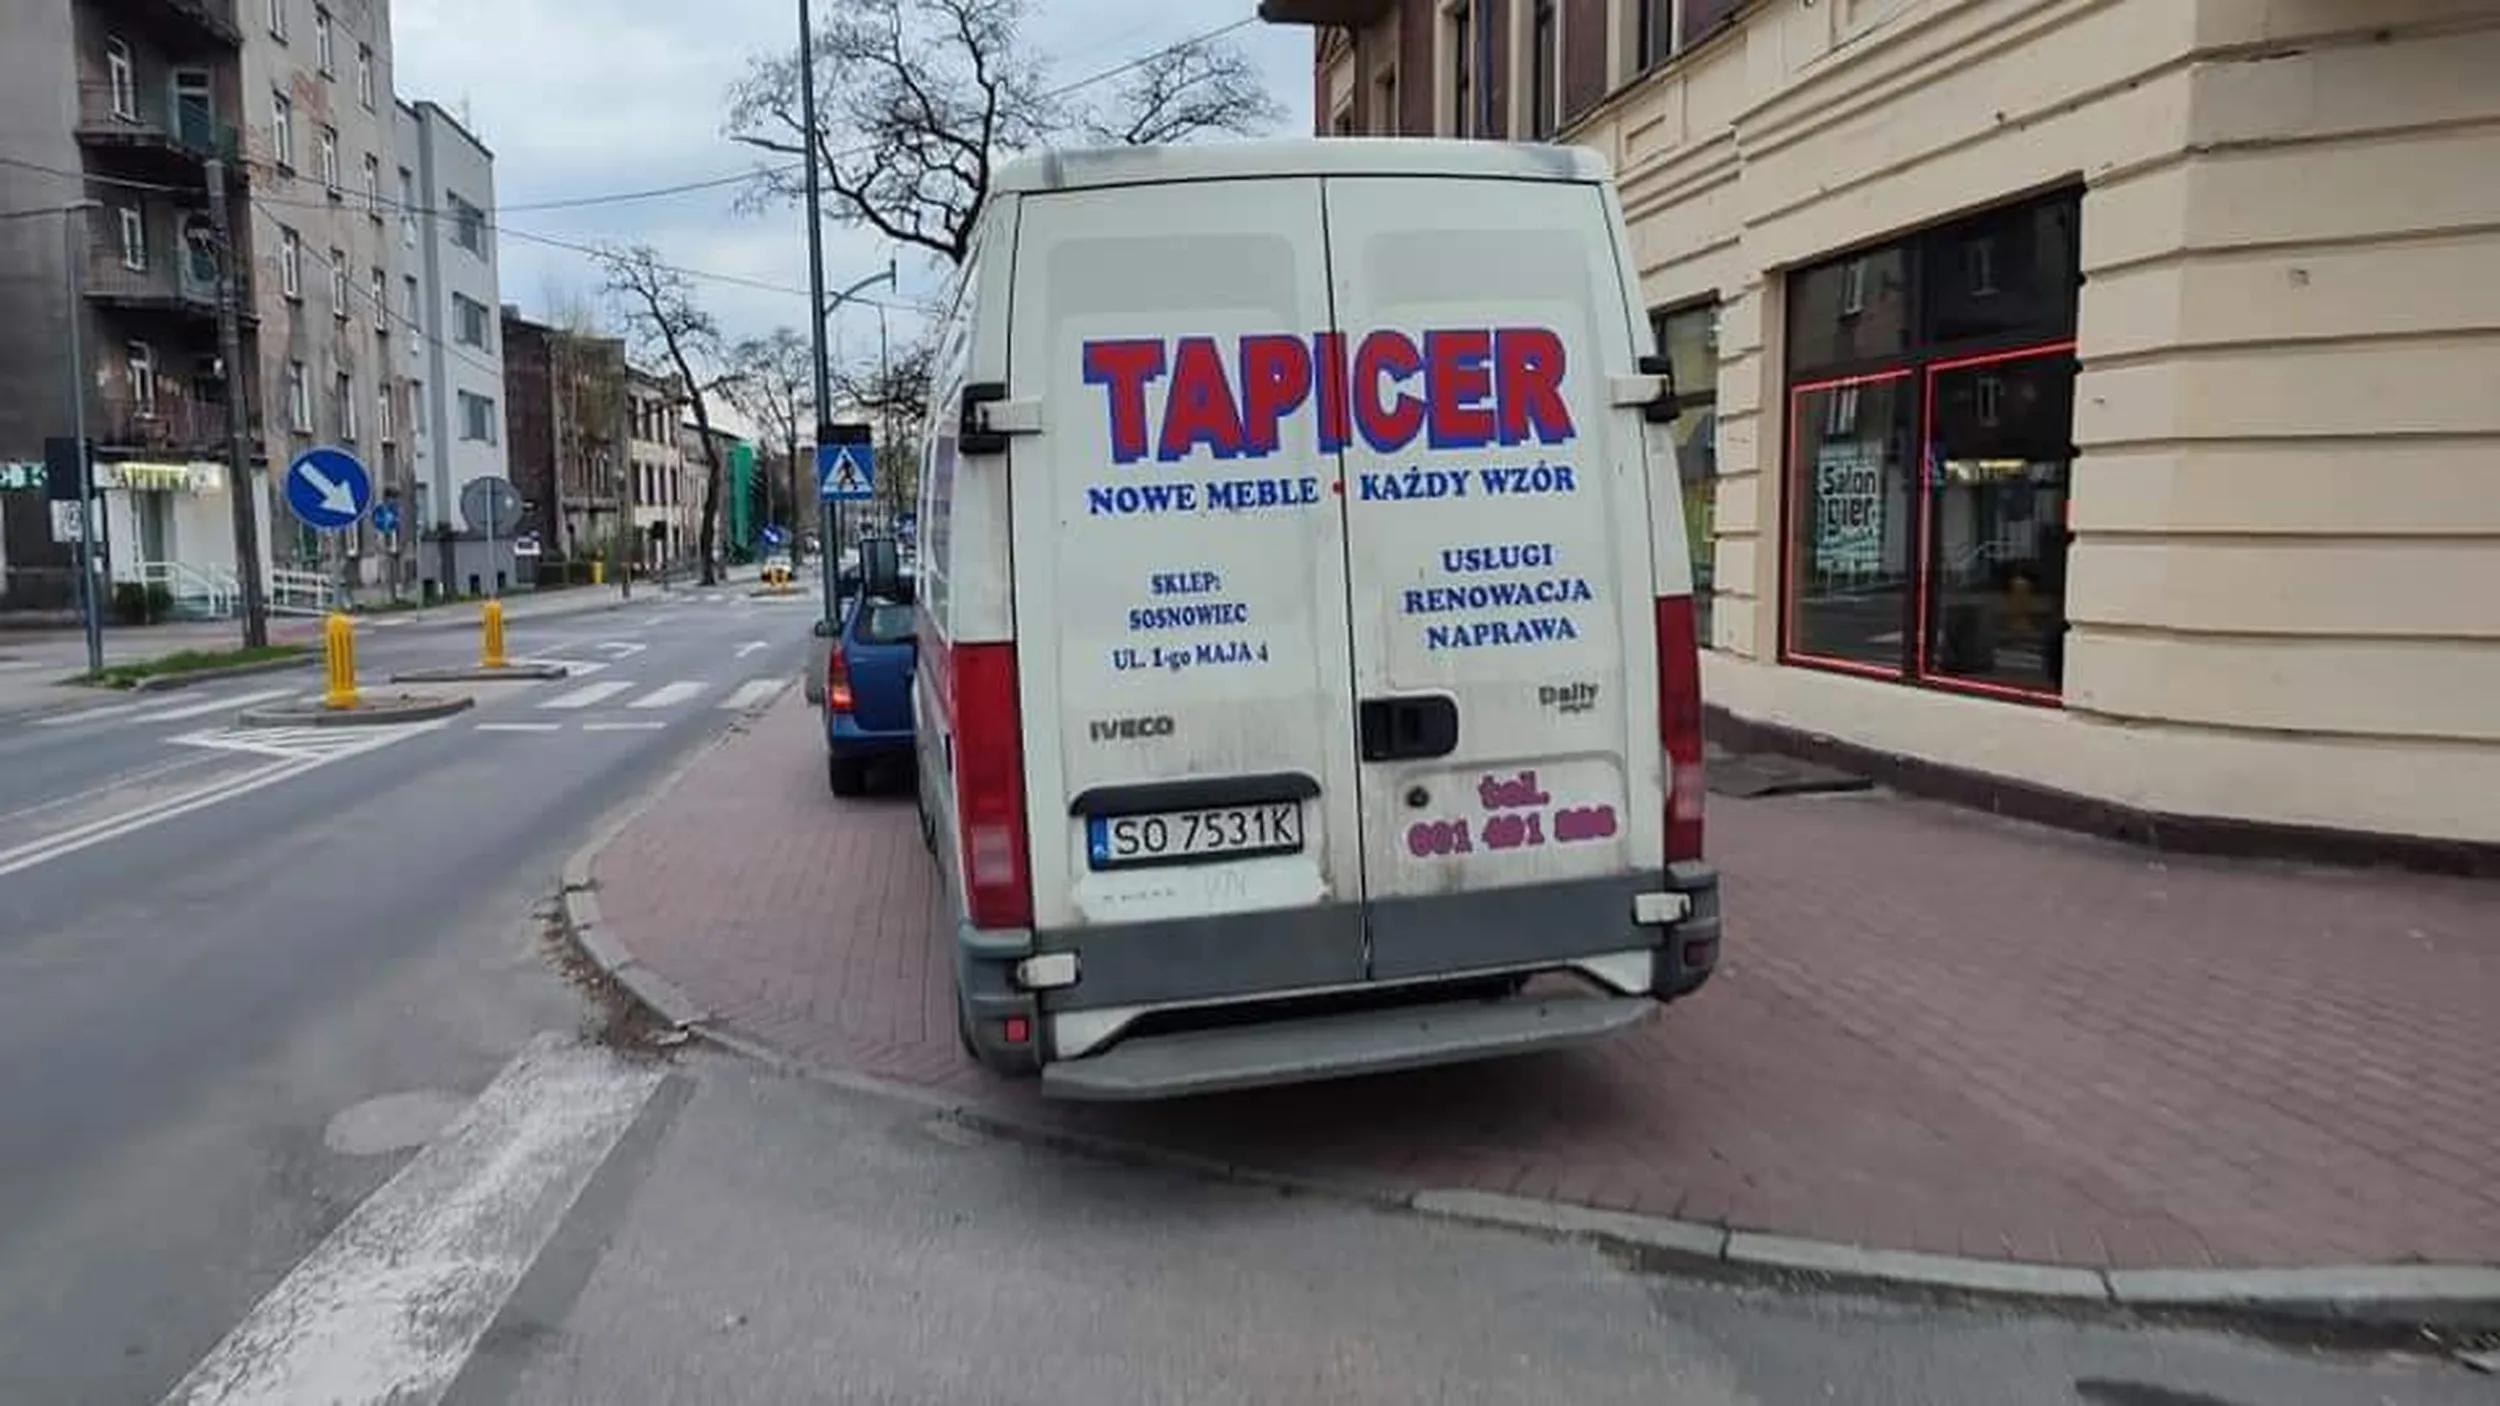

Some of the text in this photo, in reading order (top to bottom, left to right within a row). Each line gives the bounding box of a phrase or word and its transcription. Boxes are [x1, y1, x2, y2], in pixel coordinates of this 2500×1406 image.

[1083, 327, 1577, 464] TAPICER
[1087, 459, 1576, 515] NOWE MEBLE KAŻDY WZÓR
[1823, 464, 1876, 495] Salon
[1151, 572, 1221, 595] SKLEP:
[1404, 579, 1592, 614] RENOWACJA
[1128, 603, 1248, 630] SOSNOWIEC
[1427, 617, 1577, 650] NAPRAWA
[1113, 649, 1147, 670] UL.
[1196, 641, 1252, 665] MAJA
[1089, 715, 1175, 742] IVECO
[1114, 806, 1295, 856] SO 7531K
